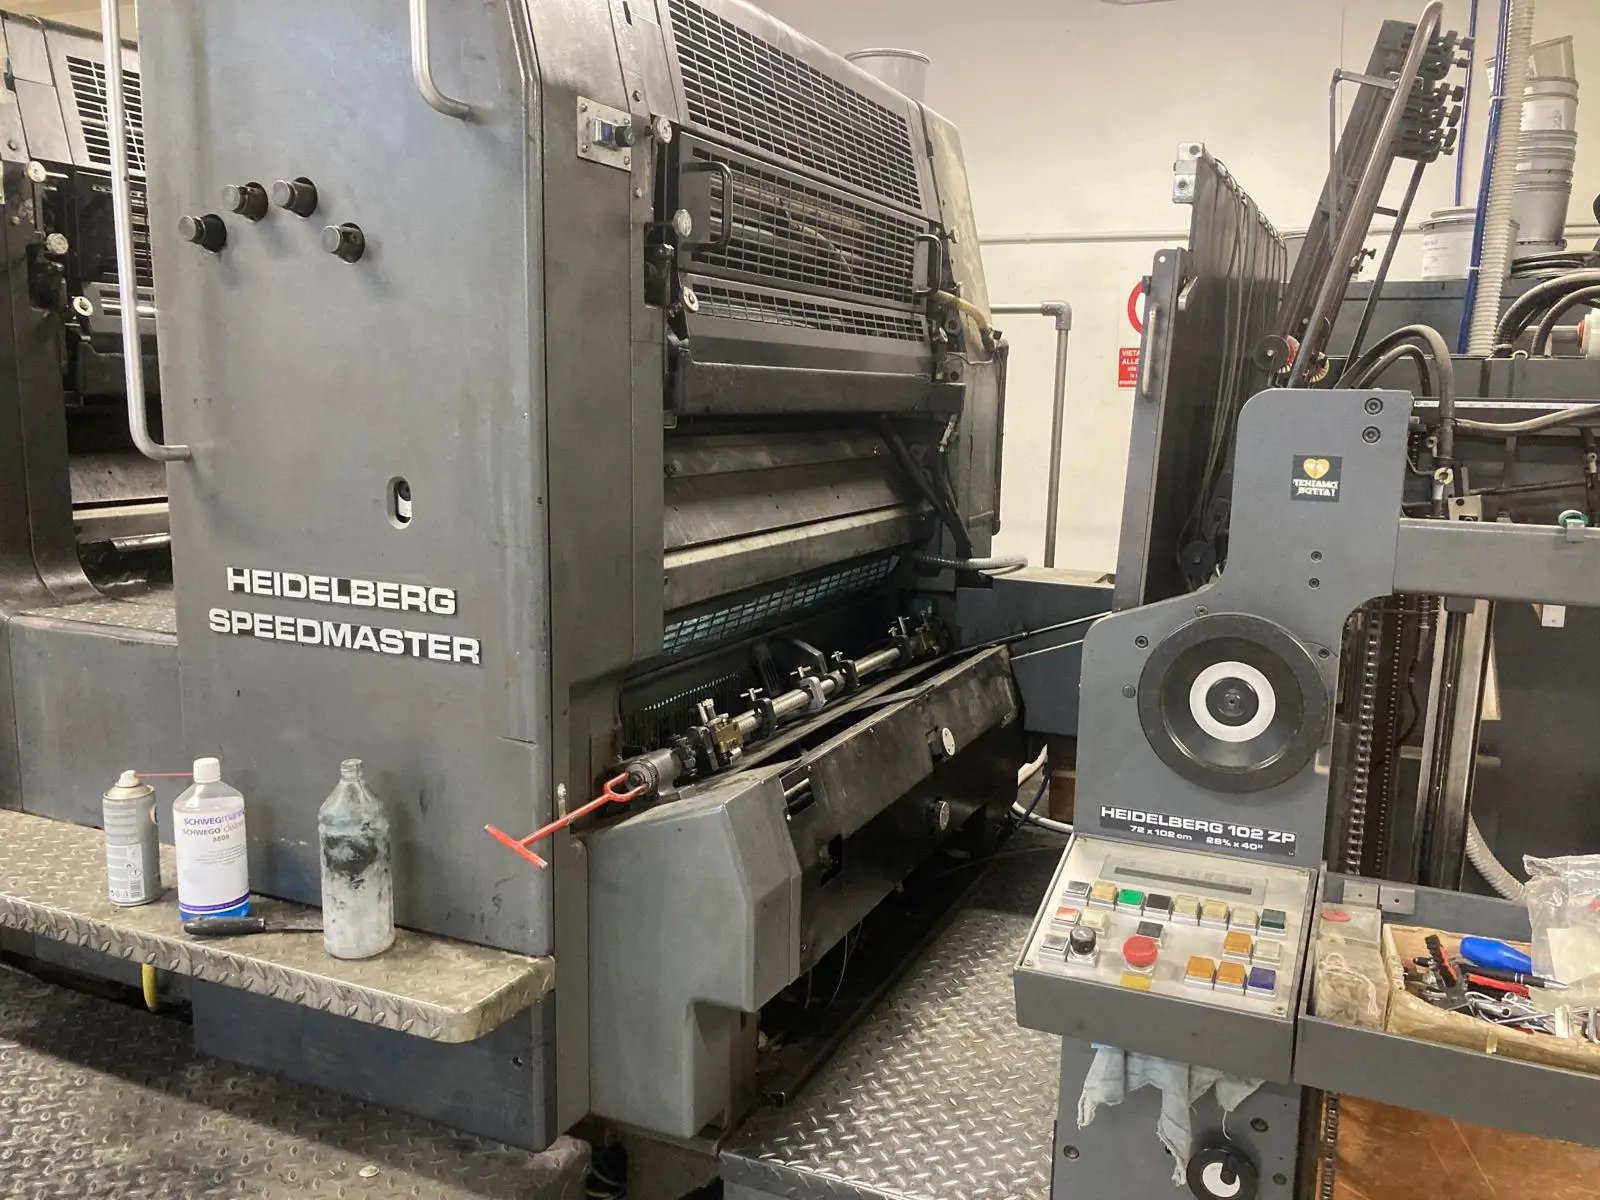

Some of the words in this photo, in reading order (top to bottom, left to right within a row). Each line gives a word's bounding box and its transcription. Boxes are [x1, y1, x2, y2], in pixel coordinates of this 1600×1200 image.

[1293, 478, 1339, 489] TENIAMO
[227, 567, 456, 615] HEIDELBERG
[209, 607, 480, 665] SPEEDMASTER
[1101, 806, 1223, 834] HEIDELBERG
[1227, 825, 1264, 840] 102
[1267, 830, 1295, 843] ZP
[1129, 825, 1145, 834] 72
[1154, 829, 1176, 838] 102
